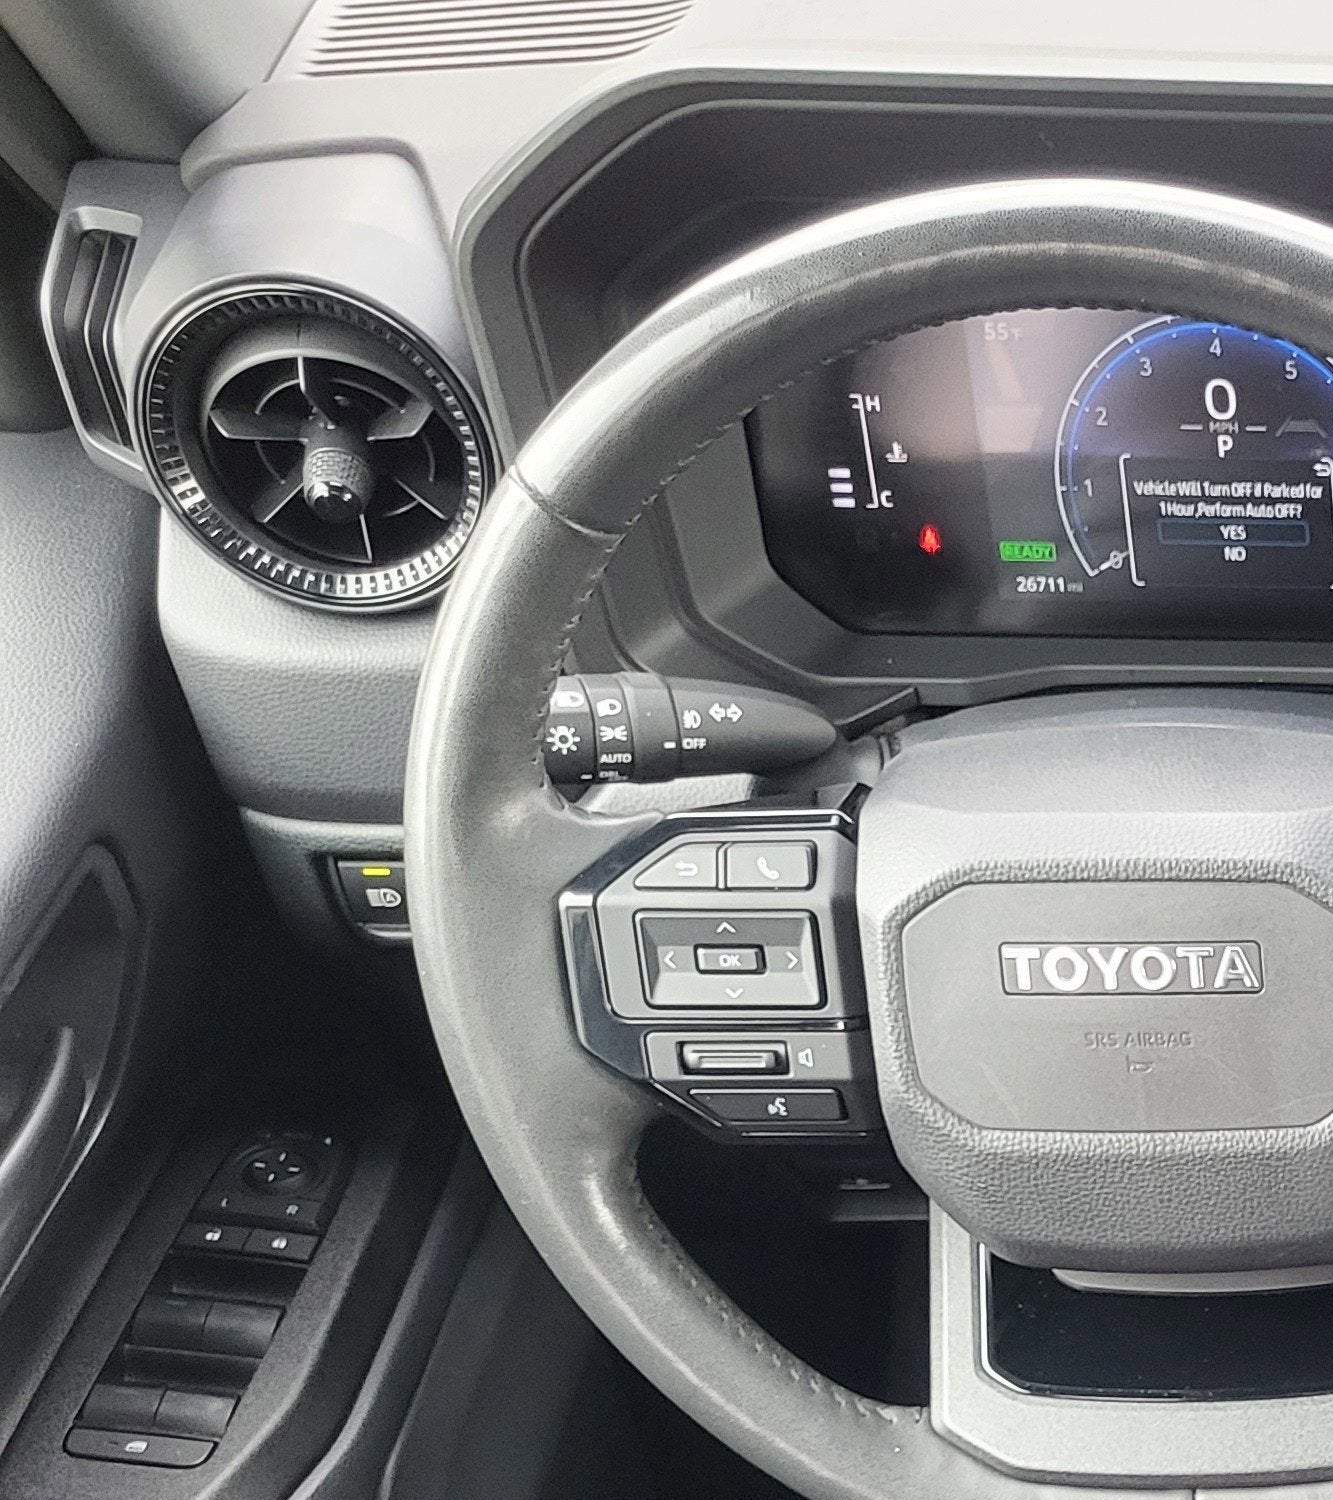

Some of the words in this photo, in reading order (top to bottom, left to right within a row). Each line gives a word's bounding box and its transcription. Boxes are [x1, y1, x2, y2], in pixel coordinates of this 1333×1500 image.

[1209, 338, 1222, 357] 4
[1139, 357, 1153, 377] 3
[1284, 361, 1299, 380] 5
[866, 395, 881, 412] H
[1204, 378, 1238, 421] 0
[1096, 407, 1109, 426] 2
[1209, 421, 1239, 434] MPH
[1217, 435, 1234, 458] P
[1083, 480, 1093, 498] 1
[1133, 481, 1177, 497] Vehicle
[1176, 482, 1201, 497] Will
[1203, 482, 1230, 498] Turn
[1231, 484, 1253, 498] OFF
[1264, 485, 1304, 499] Parked
[1305, 485, 1324, 500] for
[880, 490, 894, 508] C
[1246, 504, 1274, 518] Auto
[1220, 525, 1247, 541] YES
[1224, 546, 1247, 562] NO
[1016, 576, 1066, 593] 26711
[682, 738, 707, 750] OFF
[600, 753, 632, 764] AUTO
[718, 954, 741, 968] OK
[1000, 945, 1260, 991] TOYOTA
[1084, 1031, 1118, 1049] SRS
[1124, 1031, 1192, 1048] AIRBAG
